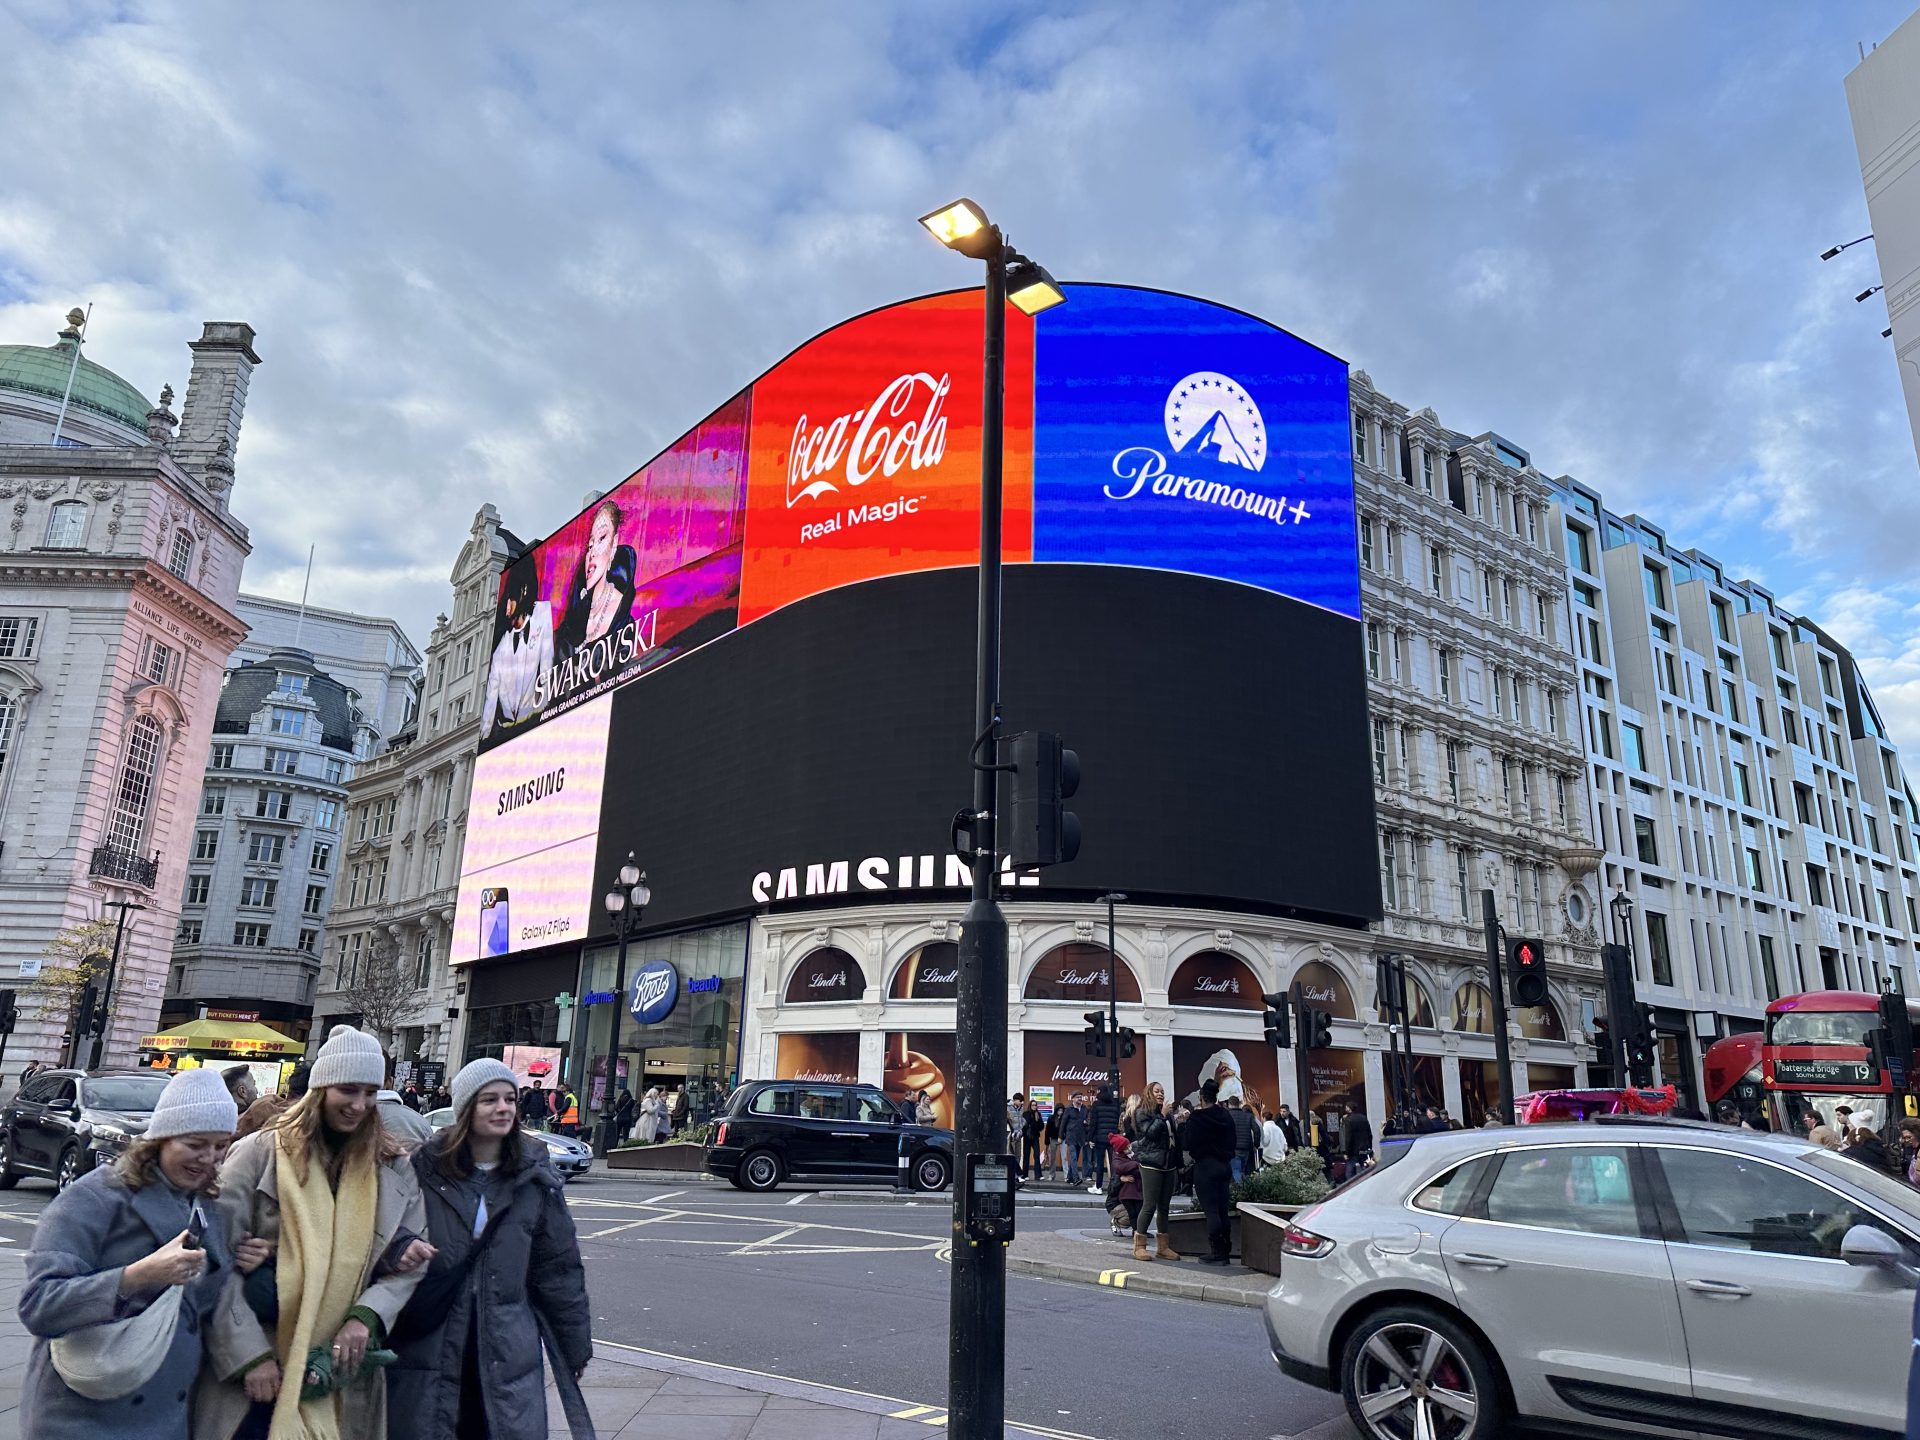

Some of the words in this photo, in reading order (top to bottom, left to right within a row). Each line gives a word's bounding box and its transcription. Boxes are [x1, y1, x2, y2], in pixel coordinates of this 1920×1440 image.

[786, 372, 950, 508] Coca-Cola
[1103, 447, 1311, 525] Paramount+
[800, 512, 842, 544] Real
[133, 600, 163, 625] ALLIANCE
[166, 620, 180, 636] LIFE
[183, 631, 203, 650] OFFICE
[532, 608, 659, 708] SWAROVSKI
[539, 706, 558, 721] ARIANA
[558, 694, 580, 713] GRANDE
[578, 692, 586, 702] IN
[585, 676, 617, 699] SWAROVSKI
[615, 664, 642, 684] MILLENIA
[497, 767, 565, 816] SAMSUNG
[521, 925, 548, 940] Galaxy
[547, 921, 553, 935] Z
[553, 916, 570, 937] Flip6
[687, 975, 722, 993] beauty
[808, 972, 840, 988] Lindt
[919, 968, 958, 983] Lindt
[1055, 969, 1099, 984] Lindt
[1193, 976, 1231, 992] Lindt
[630, 969, 671, 1014] Boots
[1303, 985, 1330, 1001] Lindt
[142, 1038, 156, 1046] HOT
[156, 1038, 170, 1046] DOG
[171, 1038, 188, 1046] SPOT
[211, 1040, 233, 1048] HOT
[234, 1041, 257, 1049] DOG
[258, 1042, 285, 1051] SPOT
[1781, 1065, 1815, 1073] Battersea
[1816, 1065, 1840, 1075] Bridge
[1854, 1066, 1870, 1080] 19
[1743, 1087, 1753, 1097] 19
